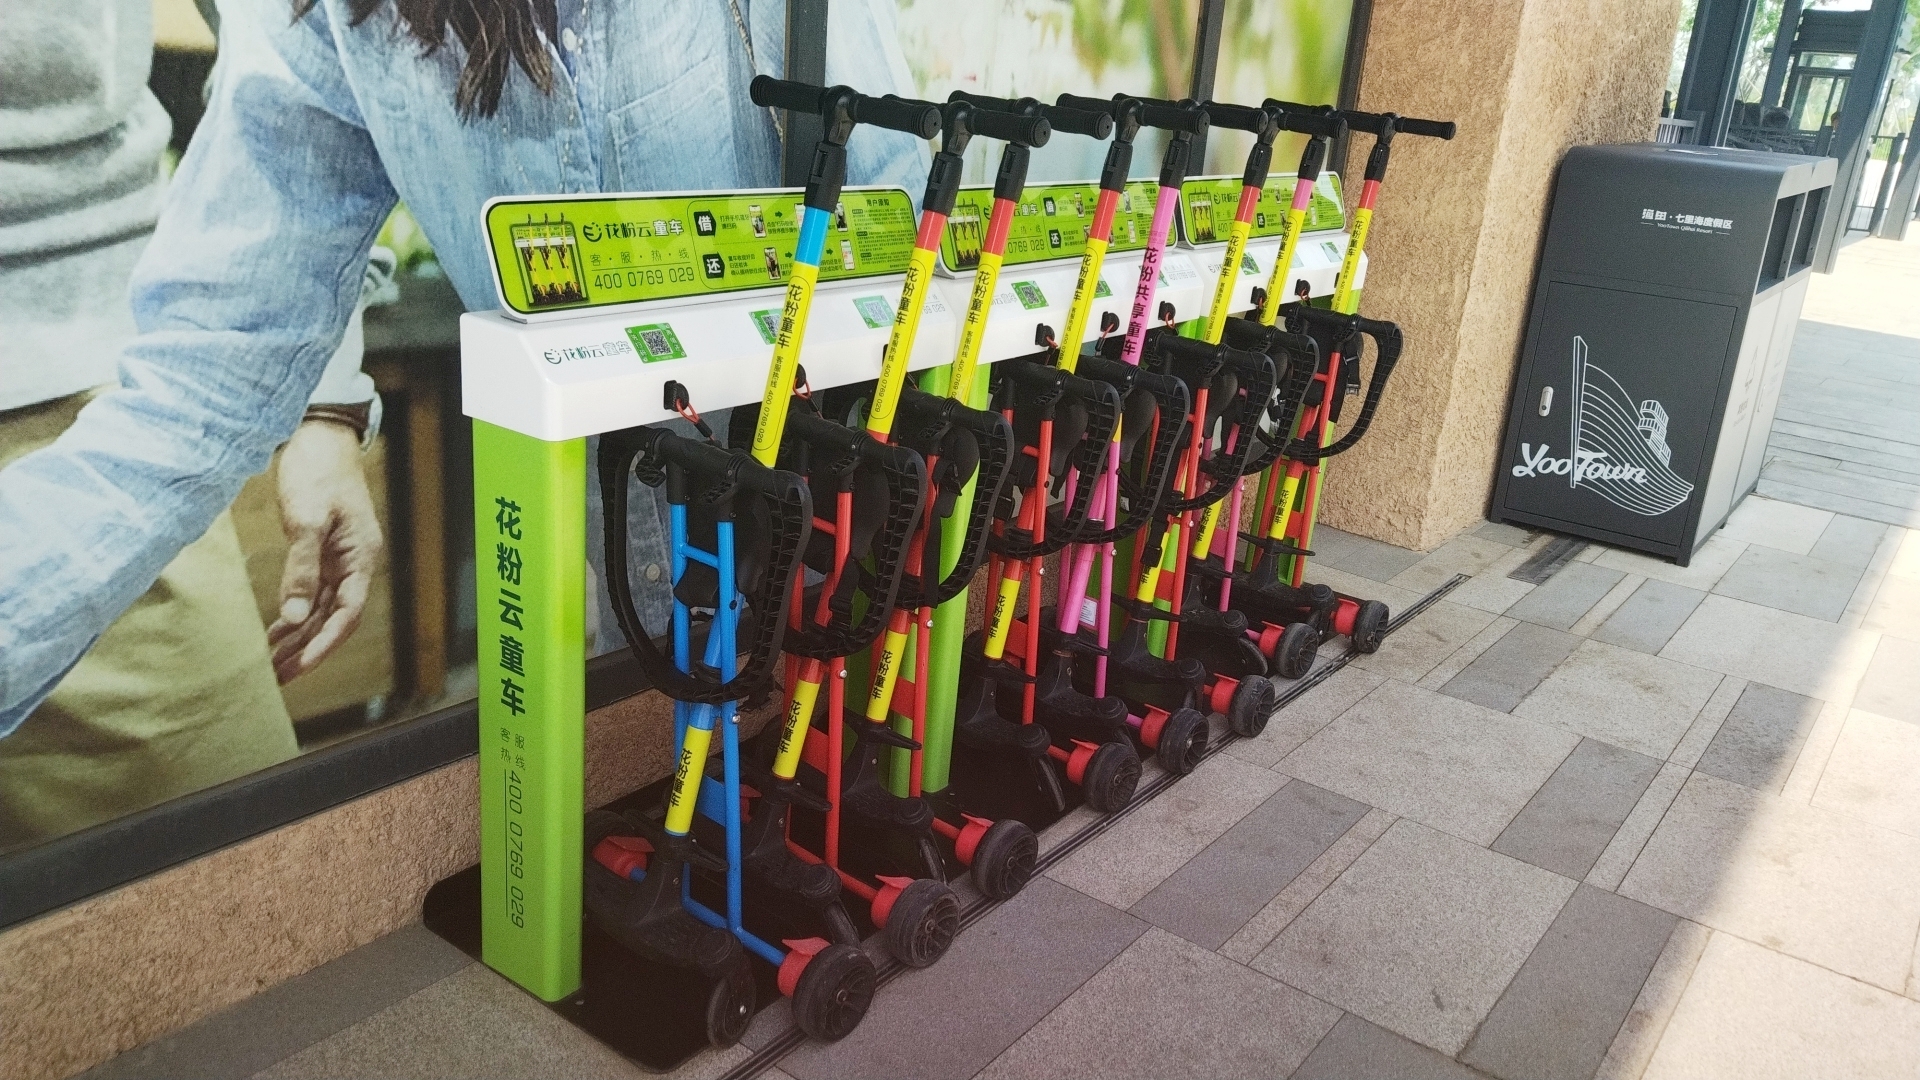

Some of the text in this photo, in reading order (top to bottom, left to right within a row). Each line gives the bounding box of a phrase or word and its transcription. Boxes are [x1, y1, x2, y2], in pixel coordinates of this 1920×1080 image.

[604, 219, 684, 239] 花粉云童车
[698, 215, 713, 232] 借
[1050, 232, 1060, 245] 还
[1277, 221, 1293, 260] 花粉童车
[1347, 220, 1364, 257] 花粉童车
[706, 258, 721, 274] 还
[1008, 239, 1045, 253] 0769 029
[1221, 235, 1239, 278] 花粉童车
[595, 267, 695, 290] 400 0769 029
[896, 266, 919, 326] 花粉童车
[968, 270, 991, 325] 花粉童车
[1073, 253, 1092, 302] 花粉童车
[777, 283, 803, 349] 花粉童车
[1123, 247, 1158, 355] 花粉共享童车
[561, 340, 632, 361] 花粉云童车
[884, 364, 892, 378] 400
[756, 355, 783, 444] 客服热线 400 0769 029
[875, 398, 883, 413] 029
[878, 378, 888, 399] 0769
[1275, 490, 1290, 524] 花粉童车
[494, 496, 526, 717] 花粉云童车
[989, 594, 1006, 639] 花粉童车
[872, 649, 893, 700] 花粉童车
[779, 699, 802, 754] 花粉童车
[671, 748, 692, 808] 花粉童车
[509, 770, 524, 928] 400 0769 029
